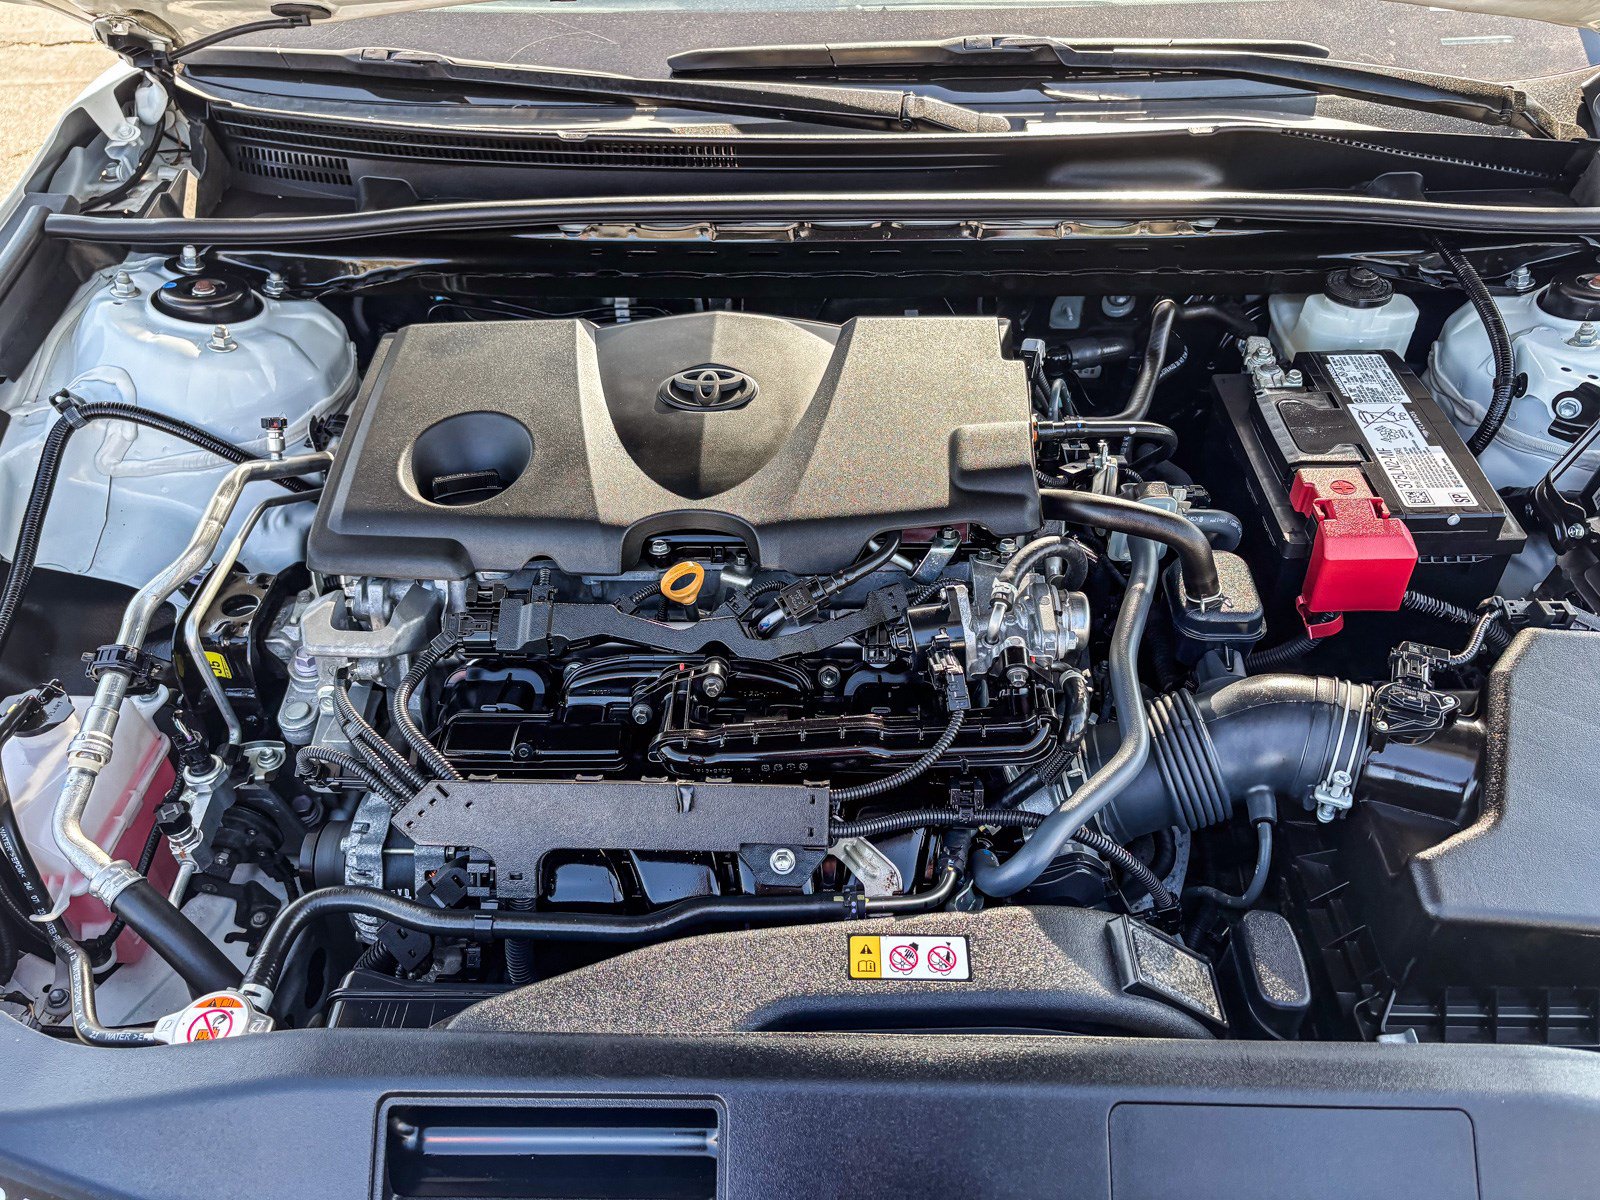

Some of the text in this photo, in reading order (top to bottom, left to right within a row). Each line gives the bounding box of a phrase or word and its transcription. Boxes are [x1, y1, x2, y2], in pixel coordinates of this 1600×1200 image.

[1376, 447, 1413, 489] 375LN2-MF
[1451, 493, 1471, 503] SP
[103, 1032, 131, 1041] WATER
